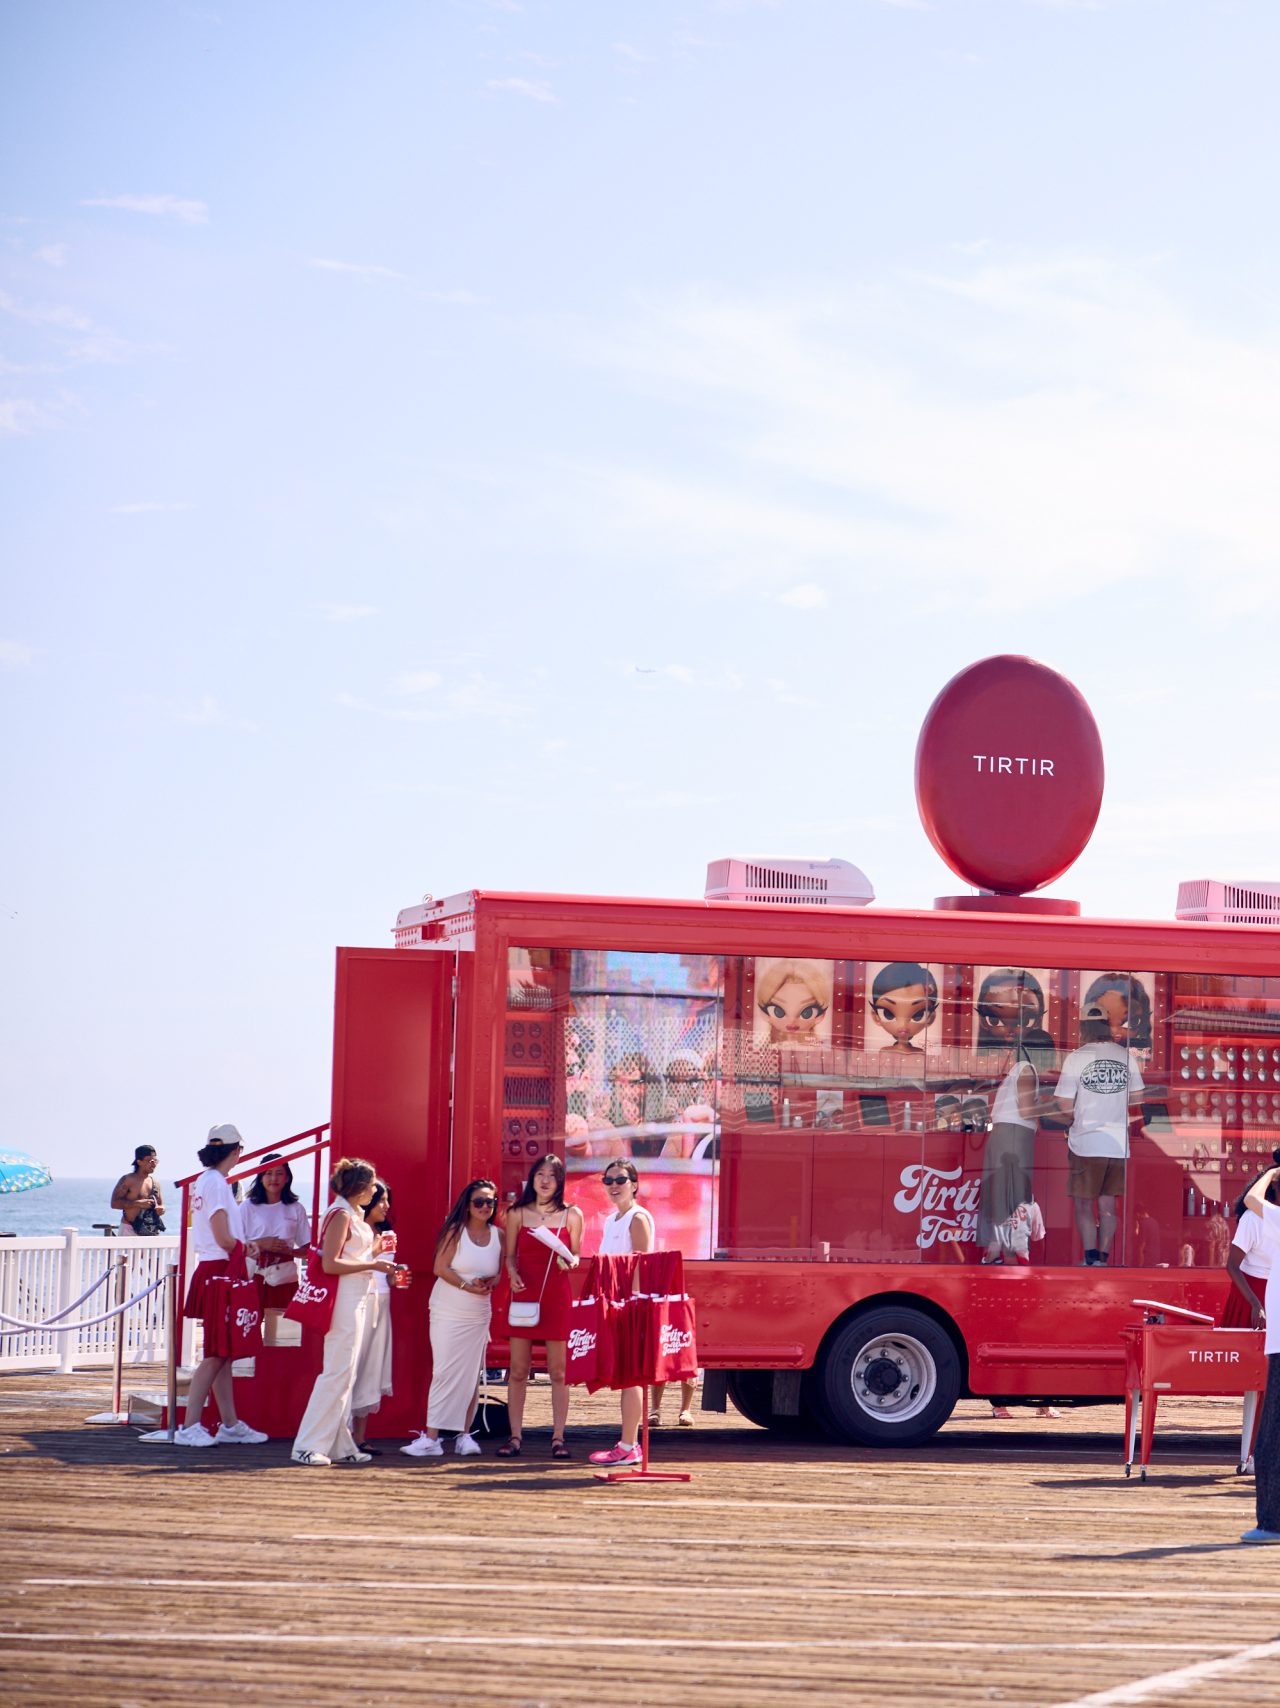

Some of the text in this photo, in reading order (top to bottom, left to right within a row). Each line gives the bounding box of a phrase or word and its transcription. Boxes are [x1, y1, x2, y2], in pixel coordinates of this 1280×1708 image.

[972, 755, 1054, 777] TIRTIR
[893, 1164, 980, 1213] Tirti
[1188, 1350, 1240, 1363] TIRTIR
